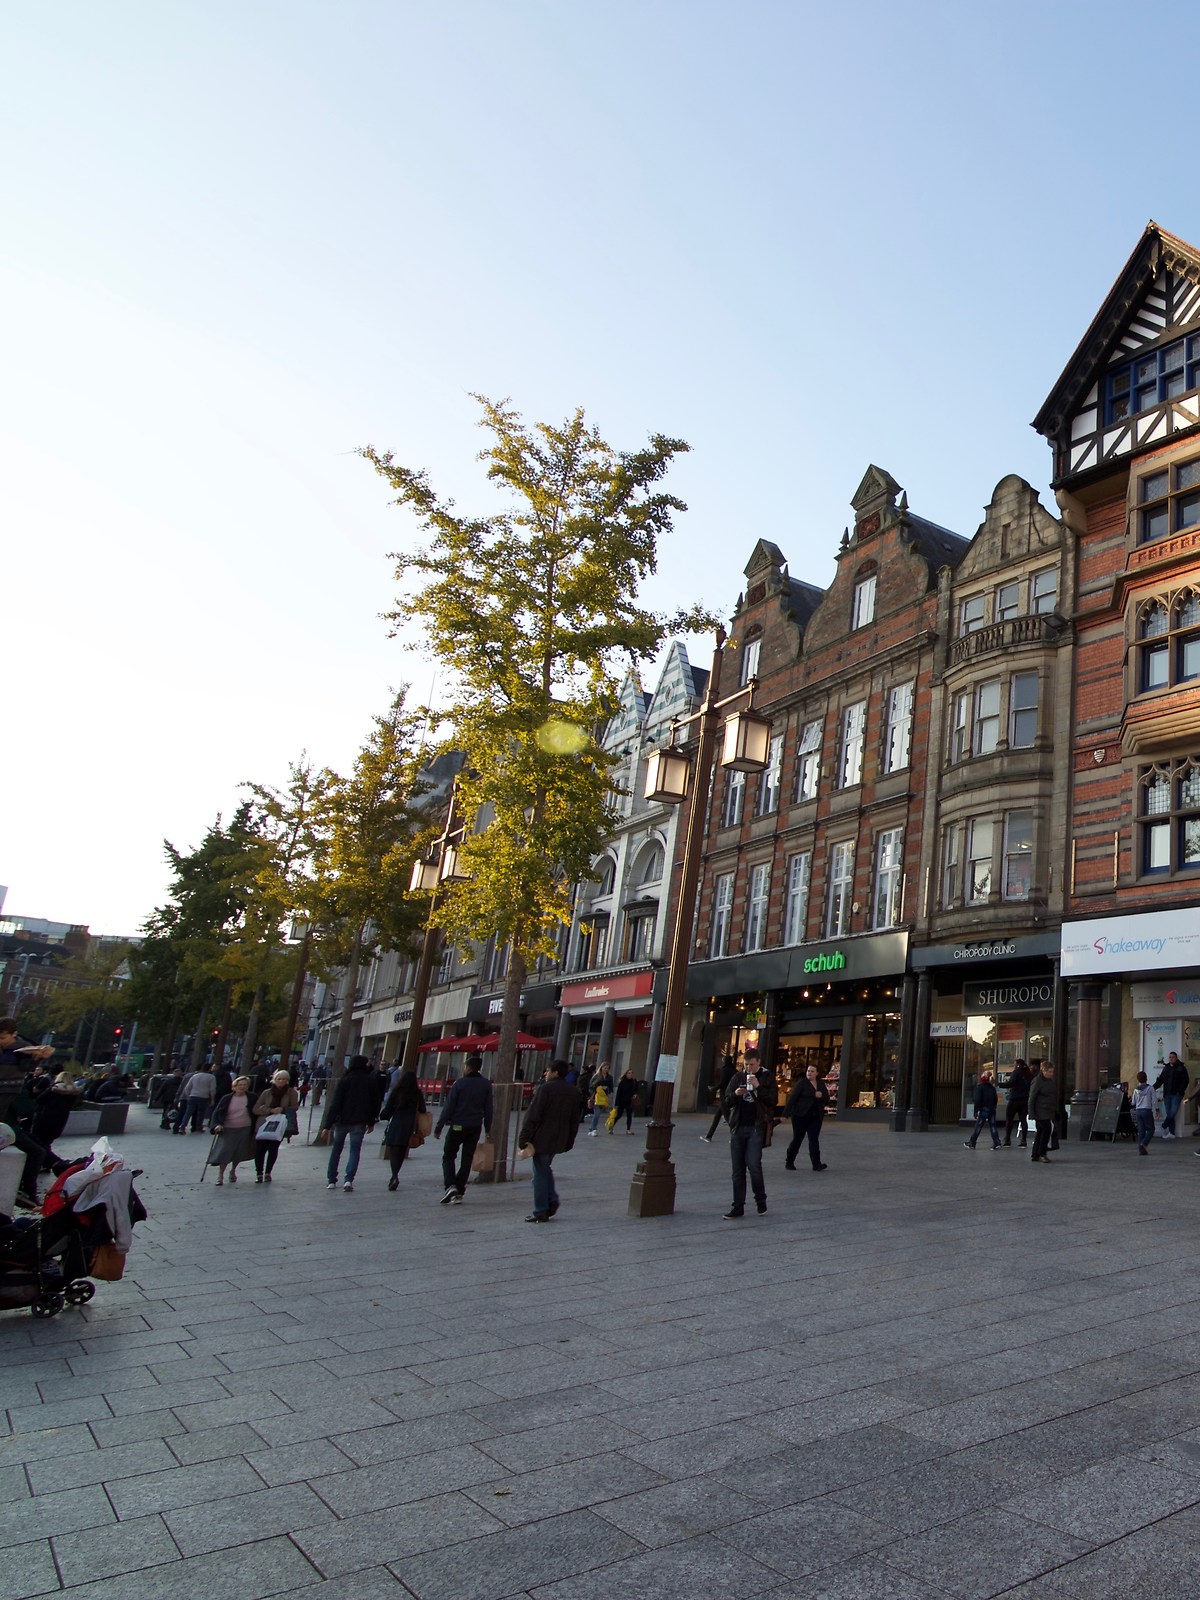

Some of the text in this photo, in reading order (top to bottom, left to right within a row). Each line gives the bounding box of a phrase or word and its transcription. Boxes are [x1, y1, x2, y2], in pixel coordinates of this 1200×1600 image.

[953, 944, 1015, 959] CHIROPODY CLINIC
[1093, 936, 1167, 955] Shakeaway
[803, 949, 846, 974] schuh
[978, 985, 1054, 1005] SHUROPO
